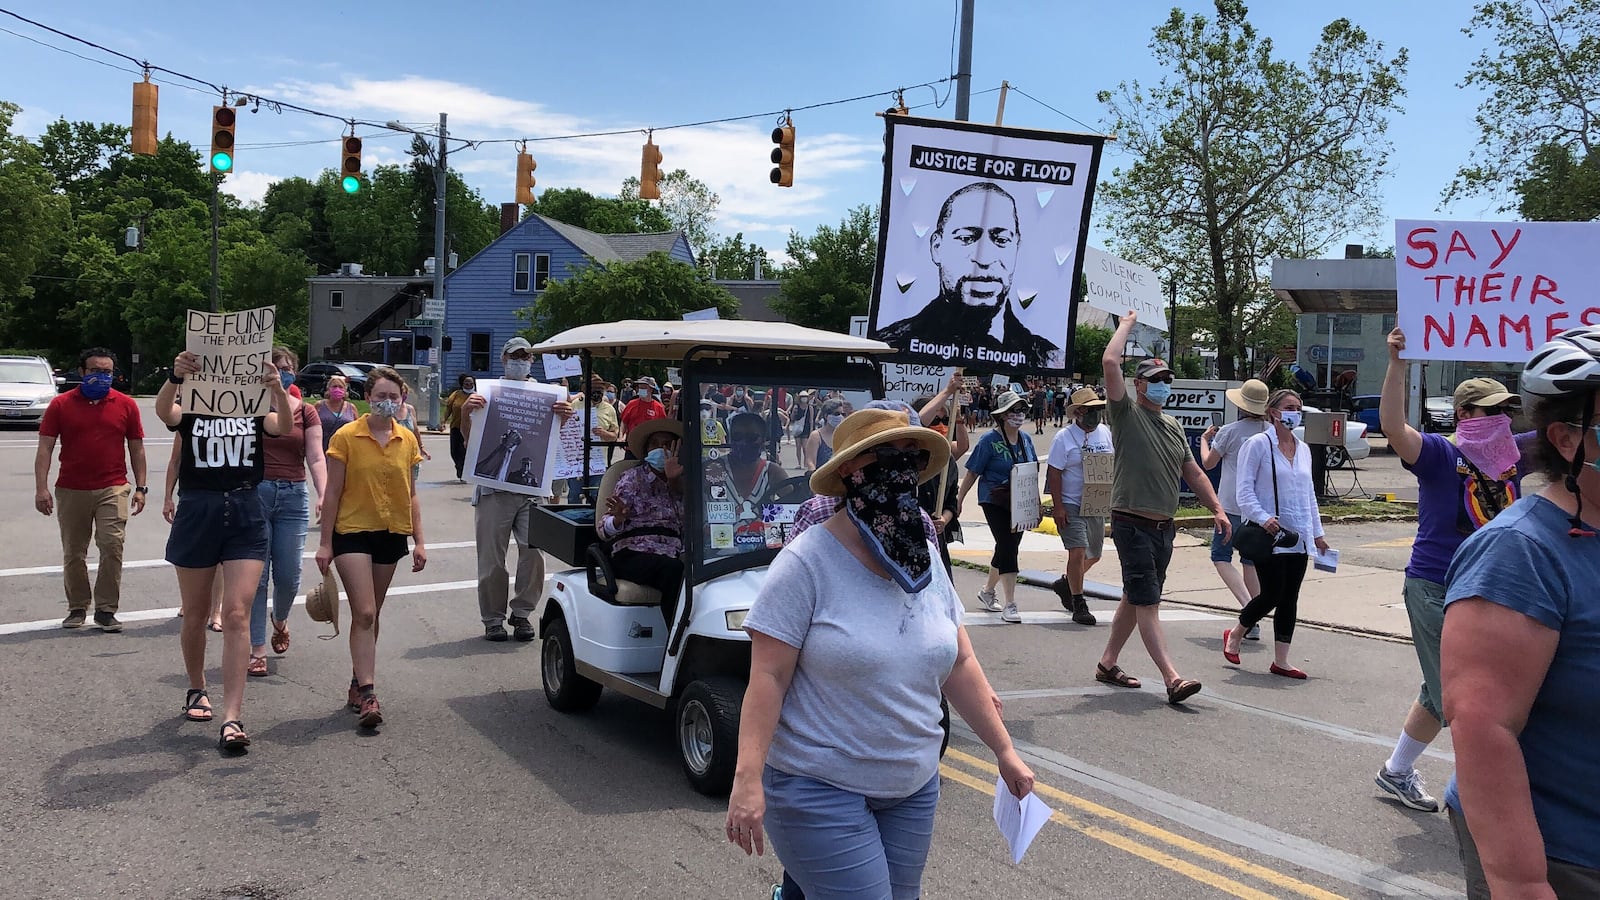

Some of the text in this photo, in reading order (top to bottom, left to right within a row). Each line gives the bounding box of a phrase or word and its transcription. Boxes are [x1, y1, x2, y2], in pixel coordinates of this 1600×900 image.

[915, 151, 1072, 182] JUSTICE FOR FLOYD
[1405, 227, 1522, 270] SAY
[1101, 258, 1147, 287] SILENCE
[1089, 281, 1160, 318] COMPLICITY
[1120, 280, 1131, 293] IS
[1423, 271, 1565, 306] THEIR
[188, 308, 275, 335] DEFUND
[200, 332, 266, 346] THE POLICE
[909, 338, 1026, 366] Enough is Enough
[194, 350, 270, 376] NVEST
[189, 373, 207, 382] IN
[210, 375, 231, 385] THE
[885, 375, 941, 395] betrayal
[190, 388, 267, 415] NOW
[1166, 390, 1216, 407] pper's
[191, 416, 257, 438] CHOOSE
[1175, 414, 1210, 426] rner
[191, 435, 257, 468] LOVE
[1084, 486, 1111, 499] Star
